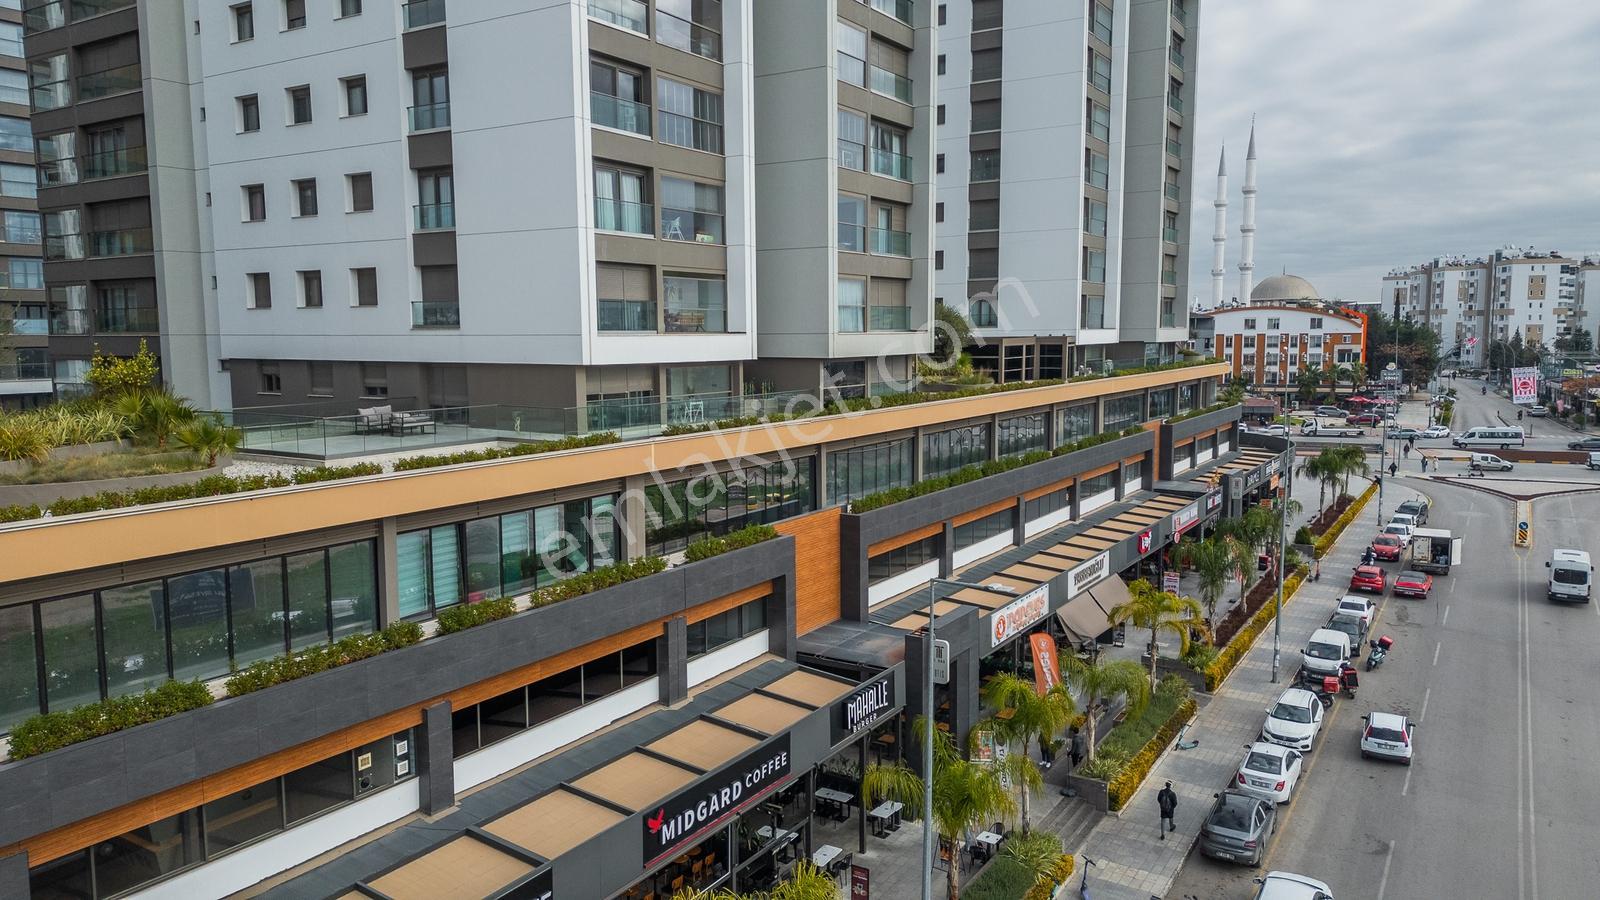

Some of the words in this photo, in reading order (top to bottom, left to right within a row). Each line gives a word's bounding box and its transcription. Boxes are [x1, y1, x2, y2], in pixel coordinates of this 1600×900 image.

[847, 680, 889, 730] MAHALLE
[852, 712, 877, 733] BURGER
[661, 781, 743, 845] MIDGARD
[745, 752, 787, 788] COFFEE
